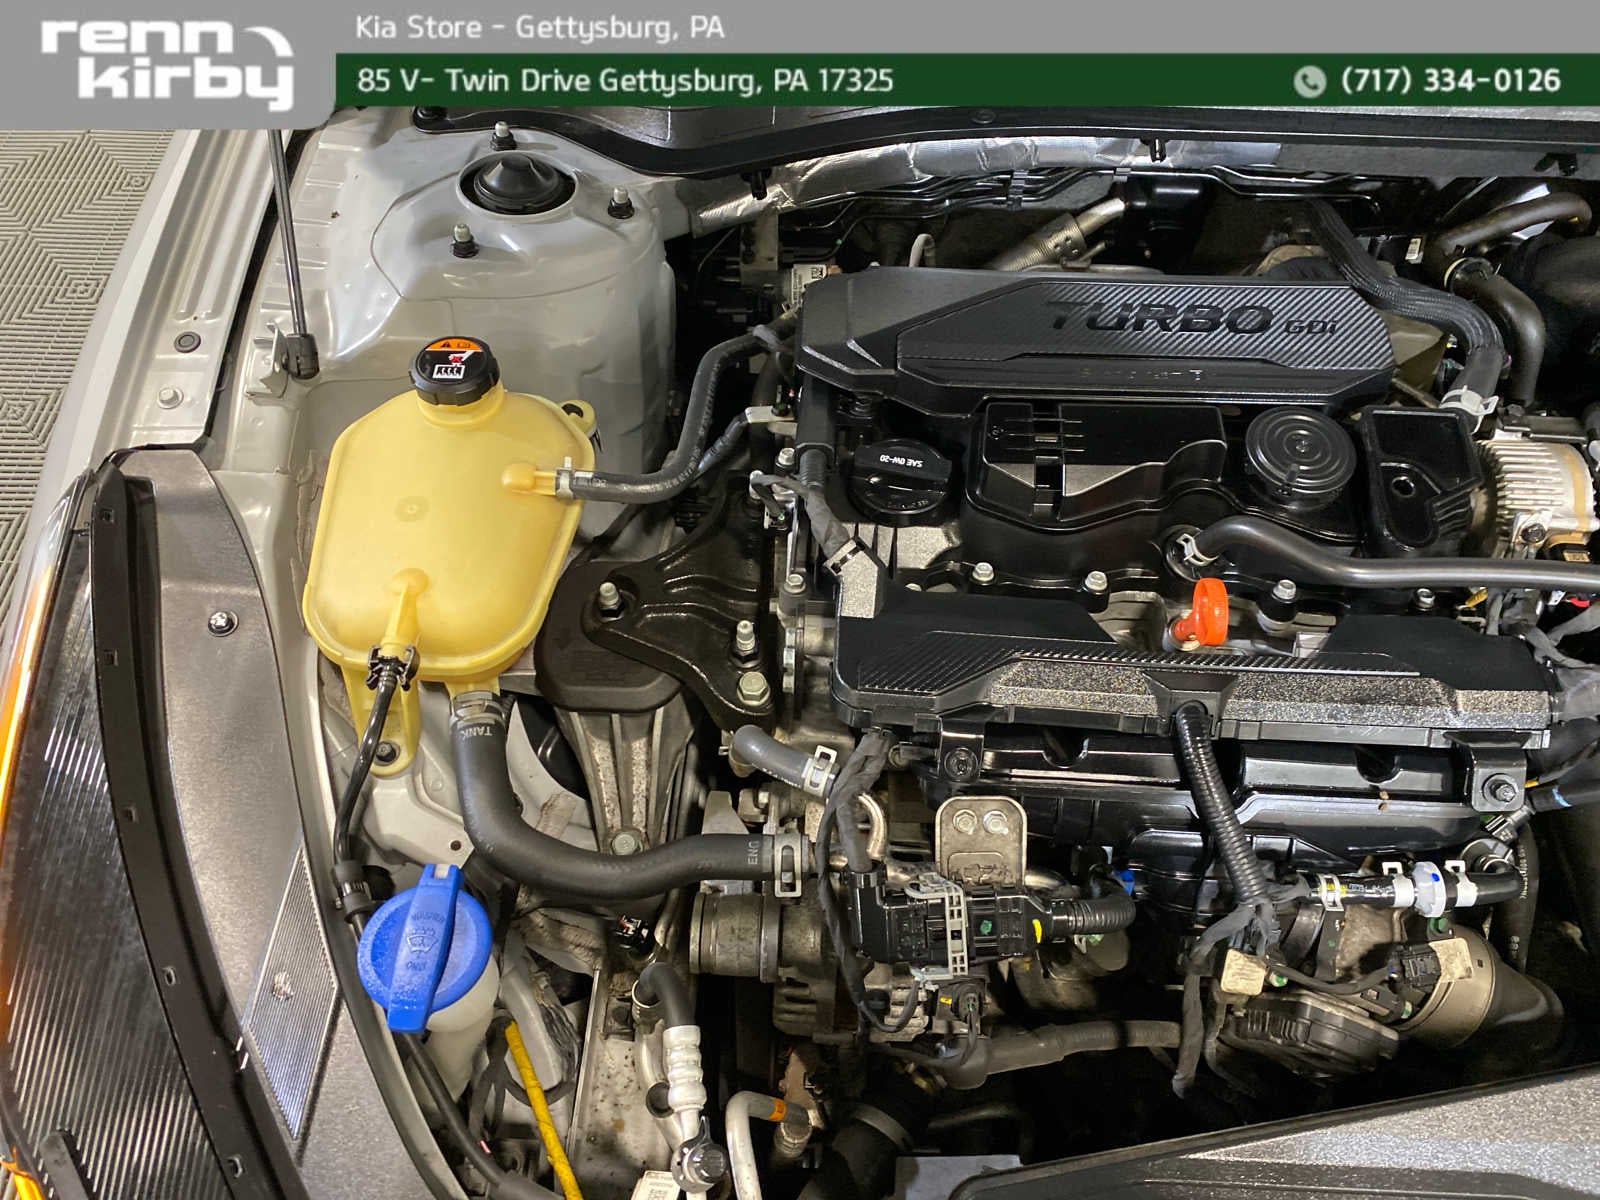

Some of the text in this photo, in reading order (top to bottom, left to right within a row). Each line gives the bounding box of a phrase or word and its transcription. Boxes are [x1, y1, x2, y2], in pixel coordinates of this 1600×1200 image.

[1047, 302, 1275, 334] TURBO
[906, 458, 924, 469] SAE
[460, 725, 493, 741] TANK
[747, 840, 761, 865] ENG
